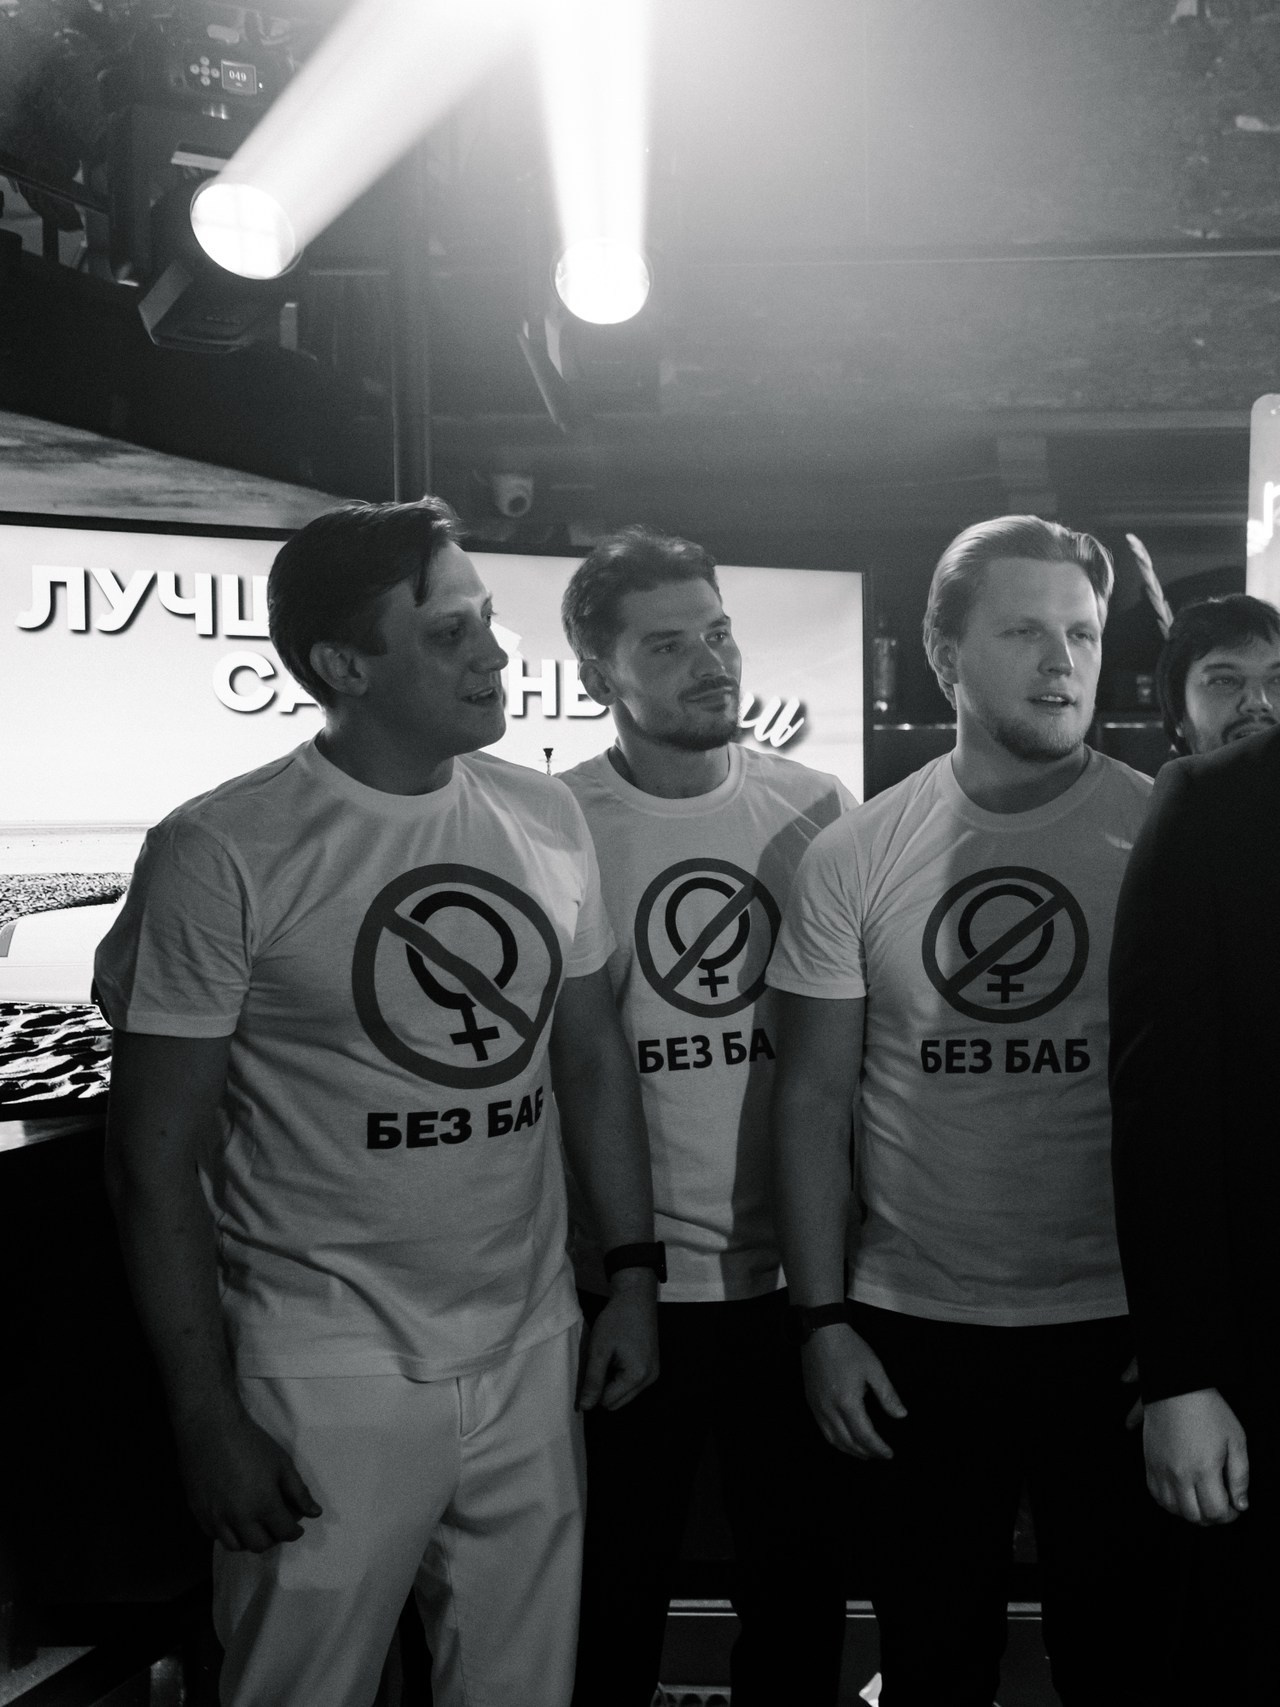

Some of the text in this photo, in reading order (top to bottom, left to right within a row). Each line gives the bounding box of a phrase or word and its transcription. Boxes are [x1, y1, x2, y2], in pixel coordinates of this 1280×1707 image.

[15, 565, 271, 638] ЛУЧШ
[637, 1028, 776, 1074] БЕЗ БА
[920, 1038, 1091, 1075] БЕЗ БАБ
[366, 1107, 473, 1150] БЕЗ
